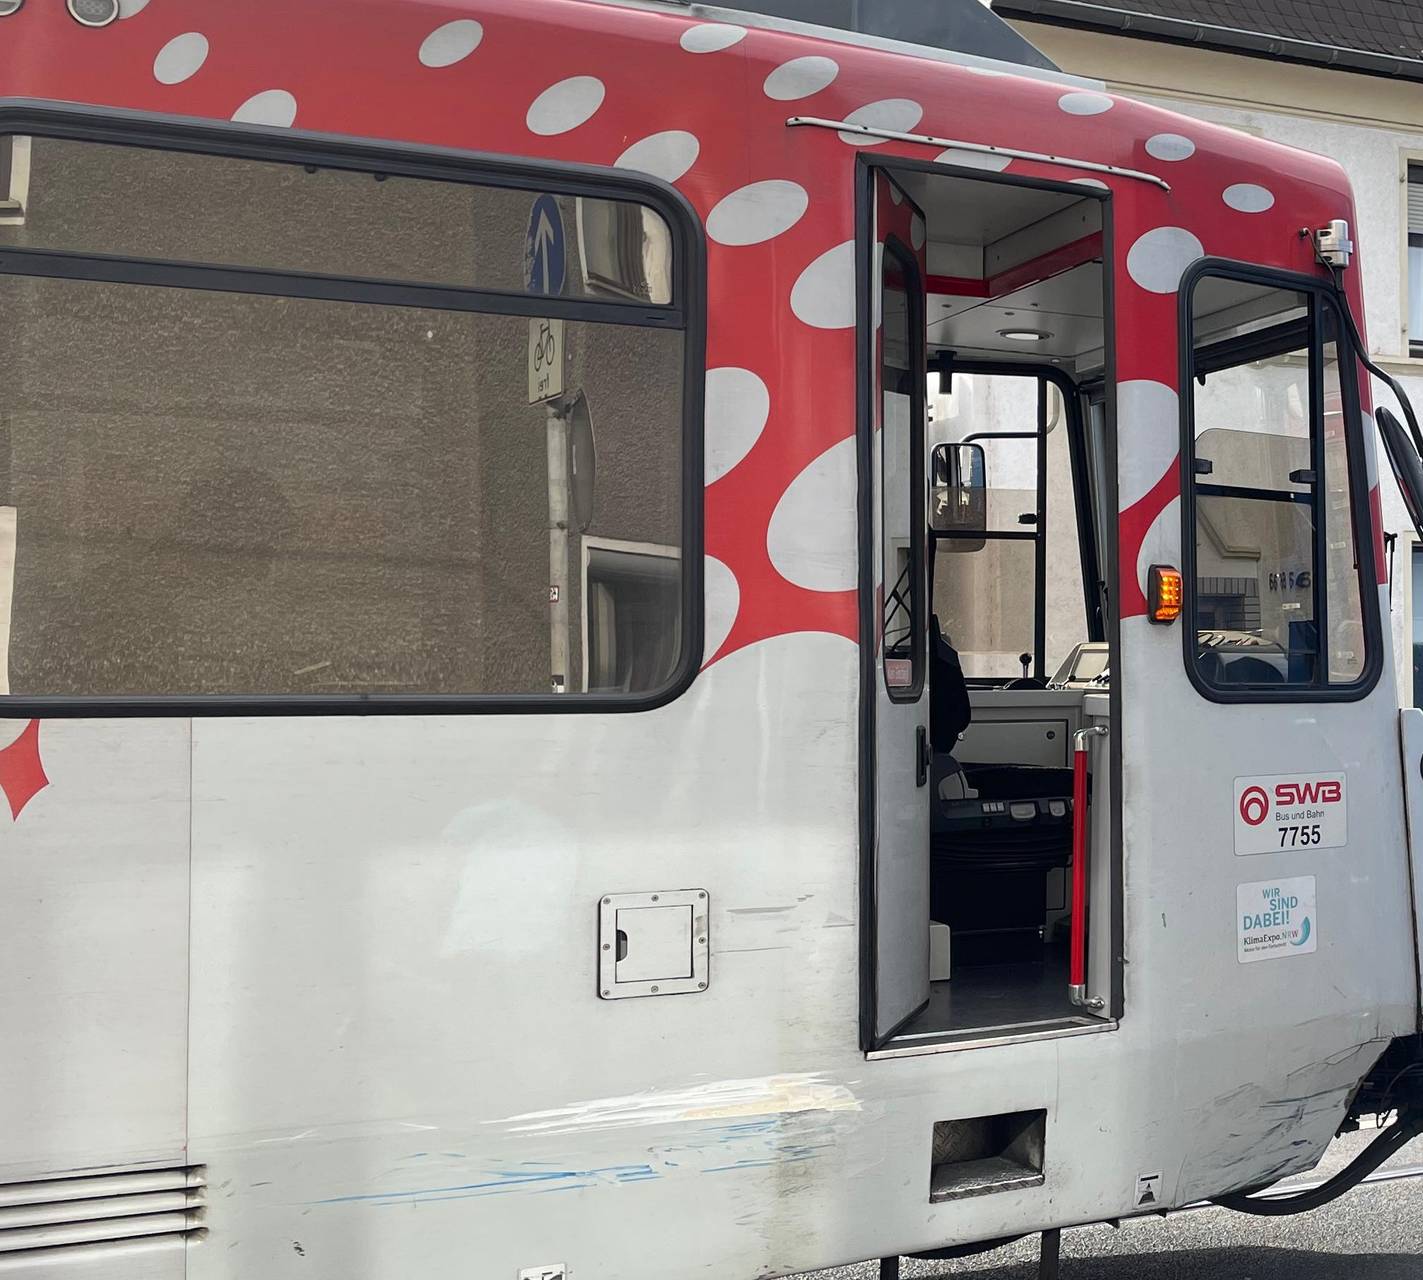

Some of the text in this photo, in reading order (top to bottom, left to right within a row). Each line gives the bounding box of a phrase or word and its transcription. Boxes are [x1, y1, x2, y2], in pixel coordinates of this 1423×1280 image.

[1275, 781, 1341, 806] SWB
[1275, 810, 1324, 821] Bus und Bahn
[1278, 824, 1321, 847] 7755
[1262, 887, 1280, 899] WIR
[1269, 896, 1298, 911] SIND
[1243, 910, 1290, 931] DABEI!
